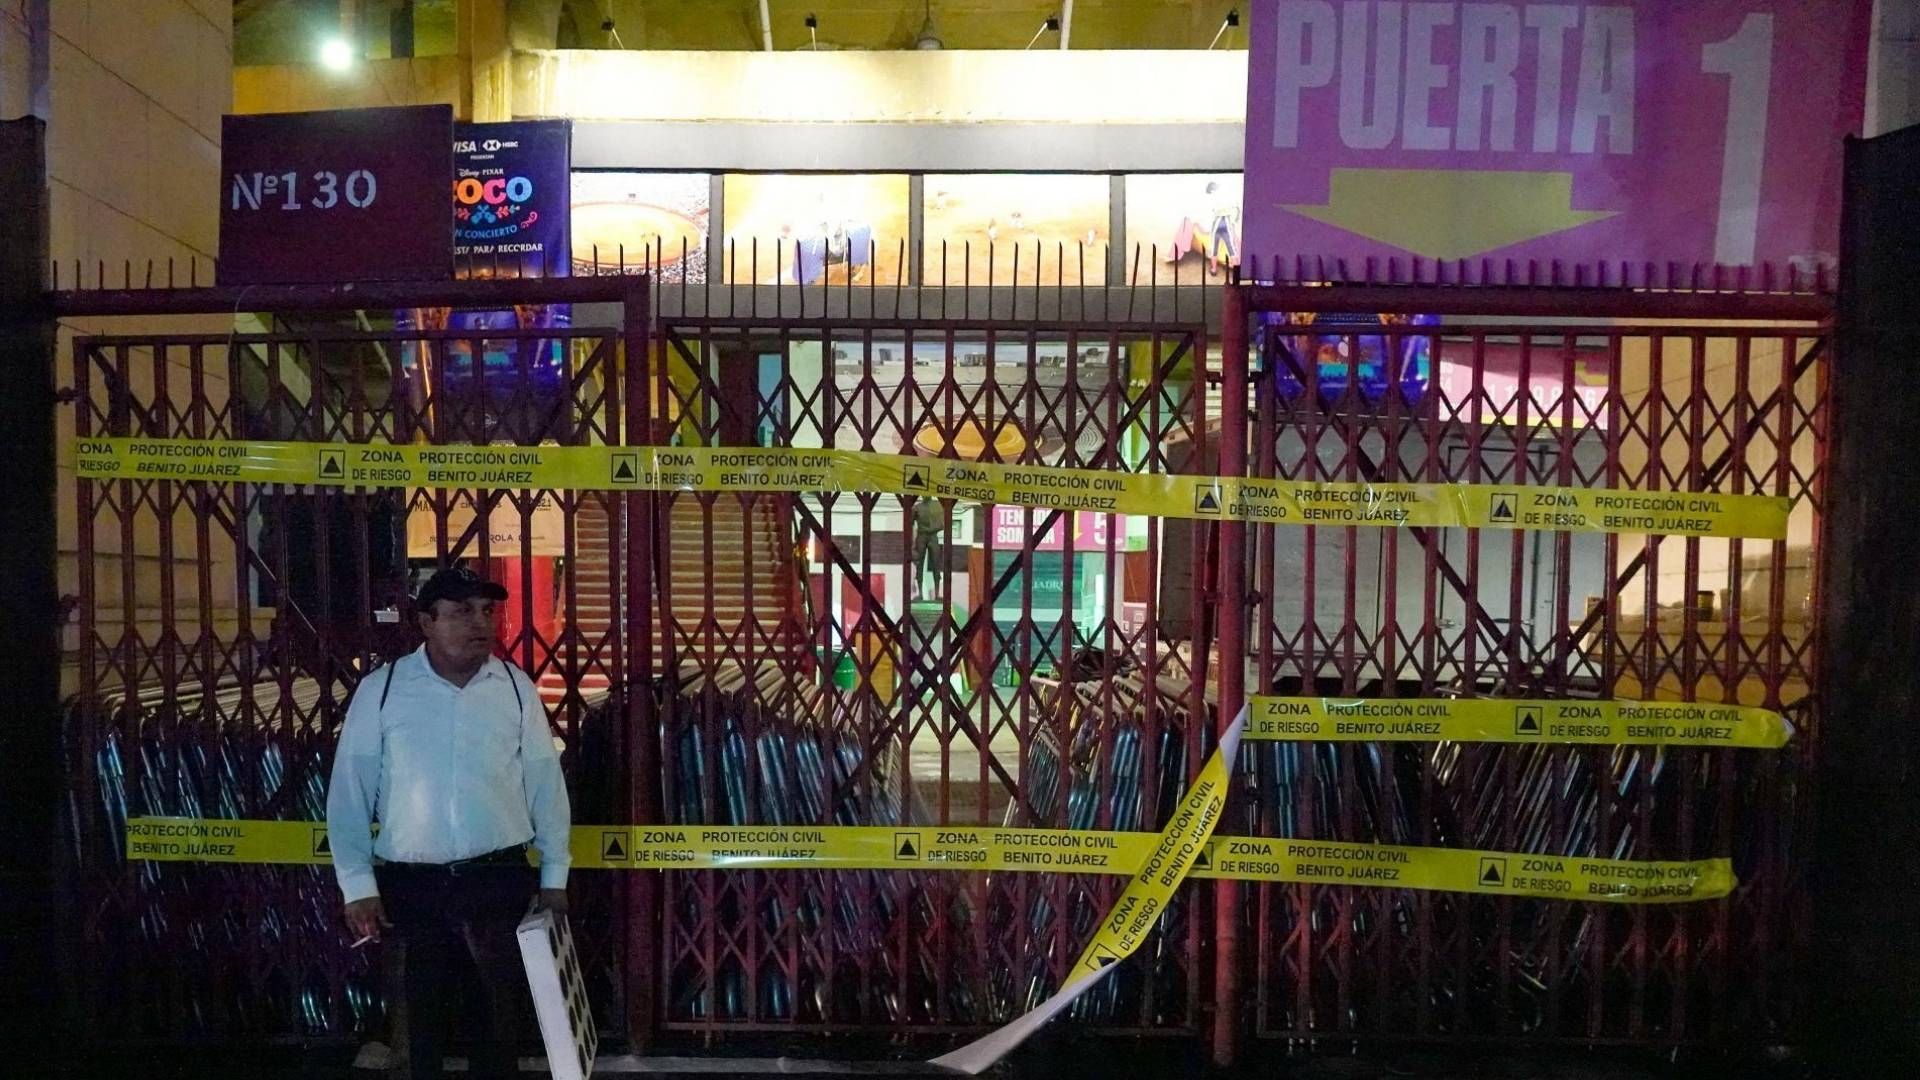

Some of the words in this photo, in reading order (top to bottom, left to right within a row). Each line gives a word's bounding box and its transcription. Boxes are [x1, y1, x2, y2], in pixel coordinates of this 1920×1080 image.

[1273, 0, 1637, 155] PUERTA
[1702, 12, 1774, 268] 1
[482, 168, 505, 176] PIXAR
[452, 176, 533, 205] OCO
[464, 224, 518, 239] CONCIERTO
[76, 443, 113, 454] ONA
[361, 451, 404, 462] ZONA
[420, 450, 506, 464] PROTECCIÓN
[510, 453, 542, 464] CIVIL
[711, 452, 797, 467] PROTECCIÓN
[802, 455, 834, 468] CIVIL
[137, 462, 186, 474] BENITO
[352, 469, 370, 480] DE
[372, 469, 410, 480] RIESGO
[428, 471, 476, 482] BENITO
[480, 469, 532, 482] JUÁREZ
[661, 473, 703, 485] RIESGO
[720, 474, 769, 484] BENITO
[773, 473, 825, 486] JUÁREZ
[946, 468, 988, 482] ZONA
[1004, 472, 1088, 489] PROTECCIÓN
[1093, 478, 1126, 492] CIVIL
[936, 484, 954, 494] DE
[954, 486, 995, 500] RIESGO
[1012, 492, 1060, 504] BENITO
[1064, 493, 1116, 509] JUÁREZ
[1238, 486, 1279, 498] ZONA
[1385, 490, 1420, 502] CIVIL
[1534, 494, 1578, 507] ZONA
[1595, 496, 1685, 512] PROTECCIÓN
[1689, 500, 1722, 513] CIVIL
[1229, 504, 1244, 515] DE
[1246, 506, 1286, 518] RIESGO
[1304, 508, 1352, 520] BENITO
[1525, 513, 1540, 524] DE
[1543, 513, 1585, 526] RIESGO
[1604, 515, 1654, 528] BENITO
[1658, 516, 1712, 531] JUÁREZ
[1268, 704, 1311, 714] ZONA
[1327, 704, 1413, 716] PROTECCIÓN
[1418, 705, 1451, 716] CIVIL
[1559, 707, 1602, 718] ZONA
[1710, 710, 1742, 721] CIVIL
[1260, 722, 1275, 732] DE
[1277, 723, 1319, 733] RIESGO
[1336, 723, 1385, 733] BENITO
[1388, 721, 1440, 734] JUÁREZ
[1550, 725, 1565, 736] DE
[1567, 726, 1610, 737] RIESGO
[1627, 726, 1676, 737] BENITO
[212, 826, 246, 838] CIVIL
[643, 832, 686, 843] ZONA
[702, 829, 788, 843] PROTECCIÓN
[792, 832, 825, 843] CIVIL
[937, 832, 978, 844] ZONA
[995, 832, 1081, 847] PROTECCIÓN
[1085, 836, 1118, 848] CIVIL
[133, 843, 179, 854] BENITO
[1230, 843, 1272, 855] ZONA
[1288, 845, 1374, 861] PROTECCIÓN
[1378, 851, 1411, 863] CIVIL
[635, 851, 650, 861] DE
[653, 851, 695, 862] RIESGO
[946, 851, 987, 862] RIESGO
[1003, 852, 1052, 864] BENITO
[1055, 851, 1108, 866] JUÁREZ
[1108, 895, 1140, 934] ZONA
[1140, 810, 1195, 885] PROTECCIÓN
[1192, 780, 1216, 809] CIVIL
[1220, 861, 1236, 872] DE
[1238, 862, 1279, 873] RIESGO
[1296, 865, 1345, 877] BENITO
[1347, 865, 1399, 880] JUÁREZ
[1522, 860, 1564, 873] ZONA
[1512, 878, 1527, 889] DE
[1530, 879, 1572, 892] RIESGO
[1120, 936, 1134, 952] DE
[1131, 897, 1159, 938] RIESGO
[1160, 842, 1194, 888] BENITO
